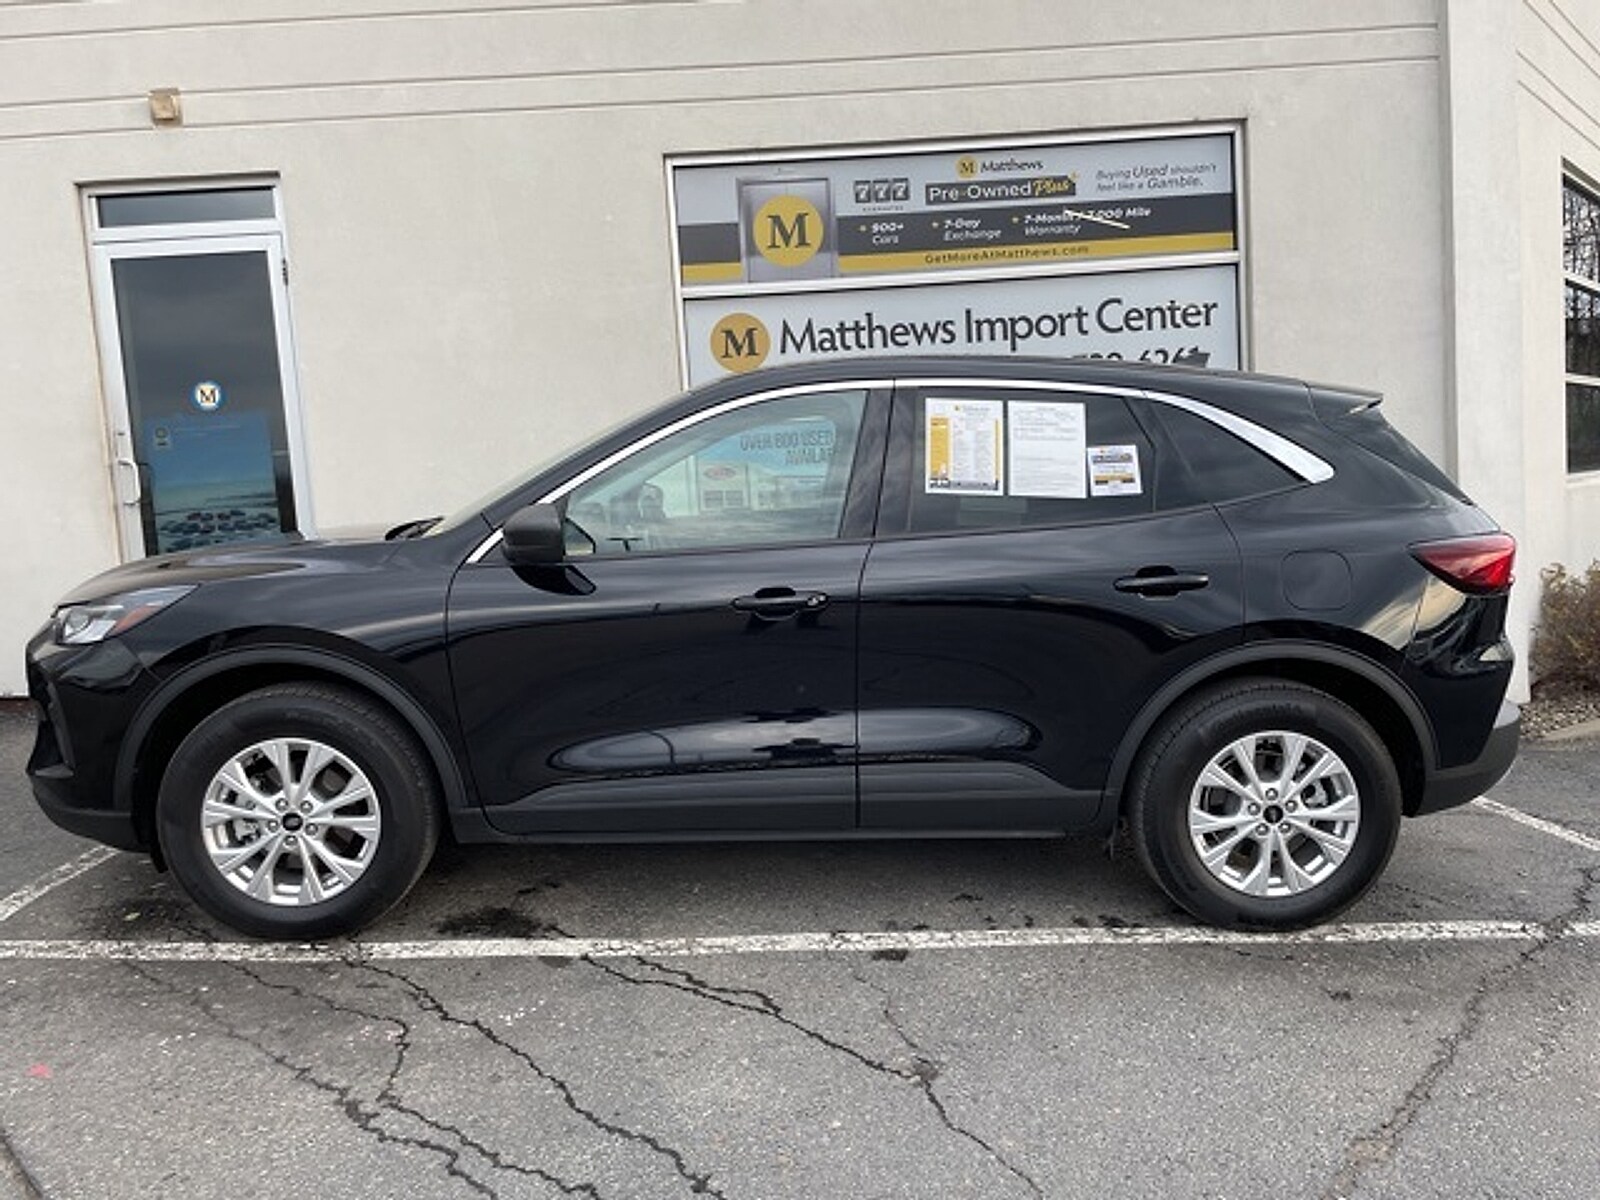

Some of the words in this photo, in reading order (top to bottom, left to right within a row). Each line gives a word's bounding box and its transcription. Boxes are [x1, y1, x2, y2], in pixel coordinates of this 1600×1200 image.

[960, 161, 975, 174] M
[980, 158, 1044, 173] Matthews
[1133, 163, 1169, 179] Used
[1147, 175, 1204, 190] Gamble.
[928, 180, 1032, 202] Pre-Owned
[766, 212, 811, 249] M
[943, 228, 1002, 243] Exchange
[1024, 223, 1082, 237] Warranty
[872, 233, 900, 245] Cars
[925, 245, 1090, 265] GetMoreAtMatthews.com
[720, 326, 760, 359] M
[780, 311, 957, 354] Matthews
[965, 306, 1089, 352] Import
[1096, 297, 1218, 334] Center
